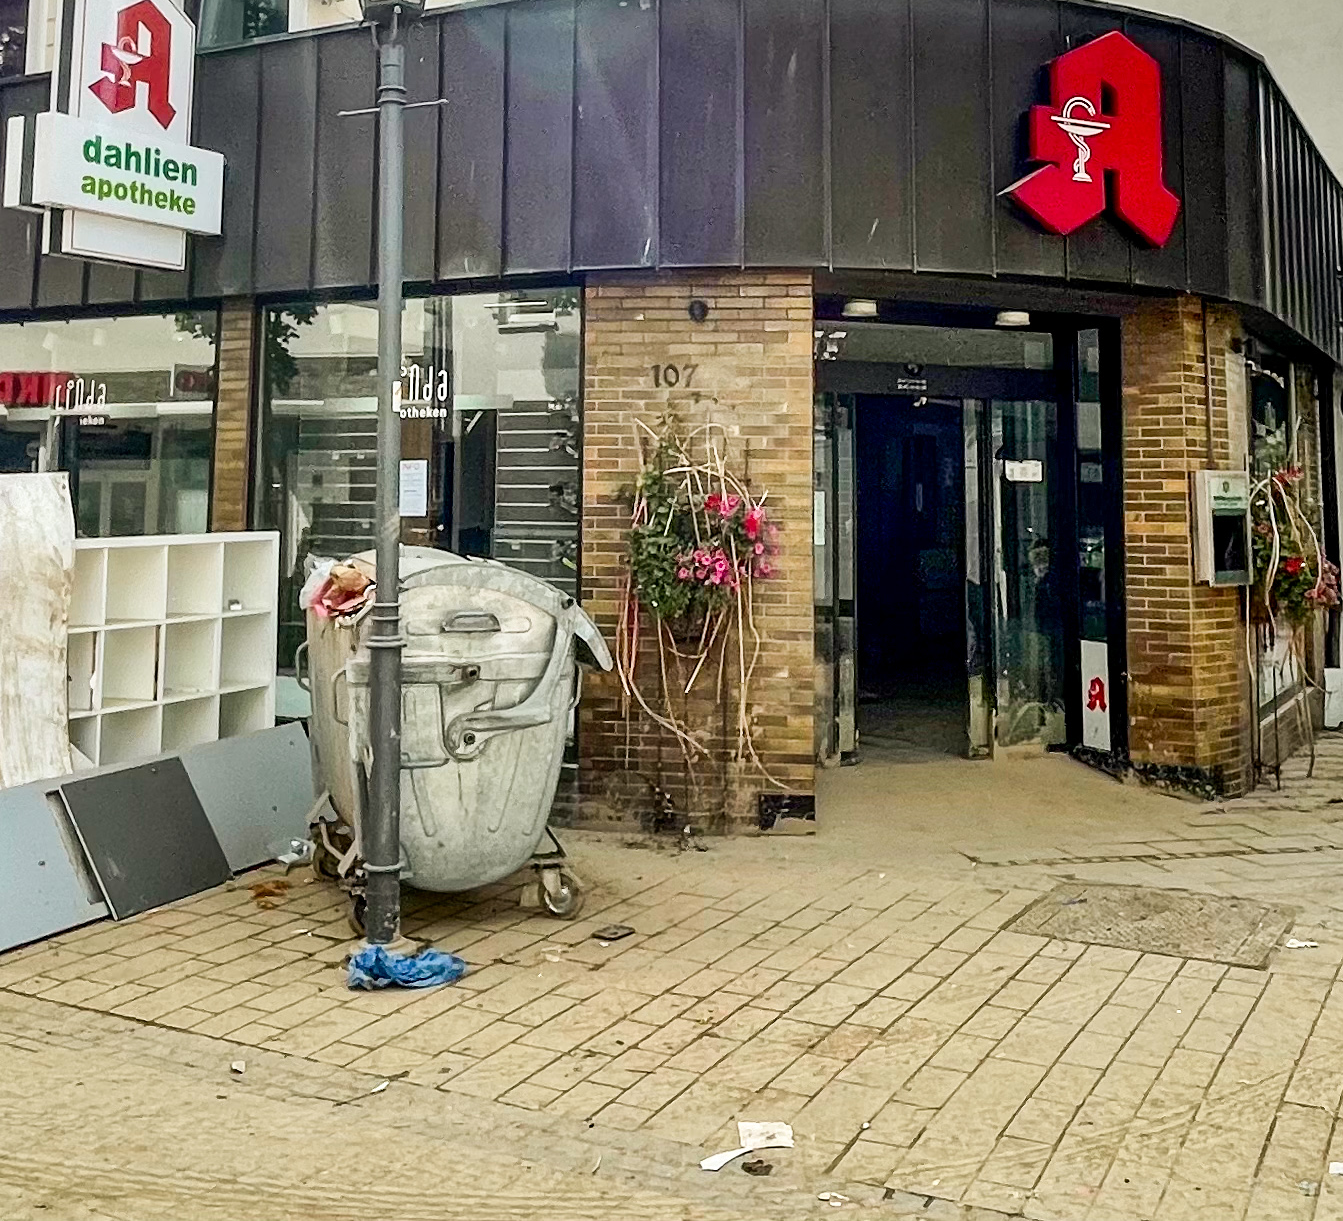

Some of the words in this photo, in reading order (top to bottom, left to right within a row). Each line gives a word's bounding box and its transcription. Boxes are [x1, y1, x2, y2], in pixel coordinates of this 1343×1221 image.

[82, 135, 198, 187] dahlien
[80, 173, 197, 216] apotheke
[651, 363, 699, 389] 107
